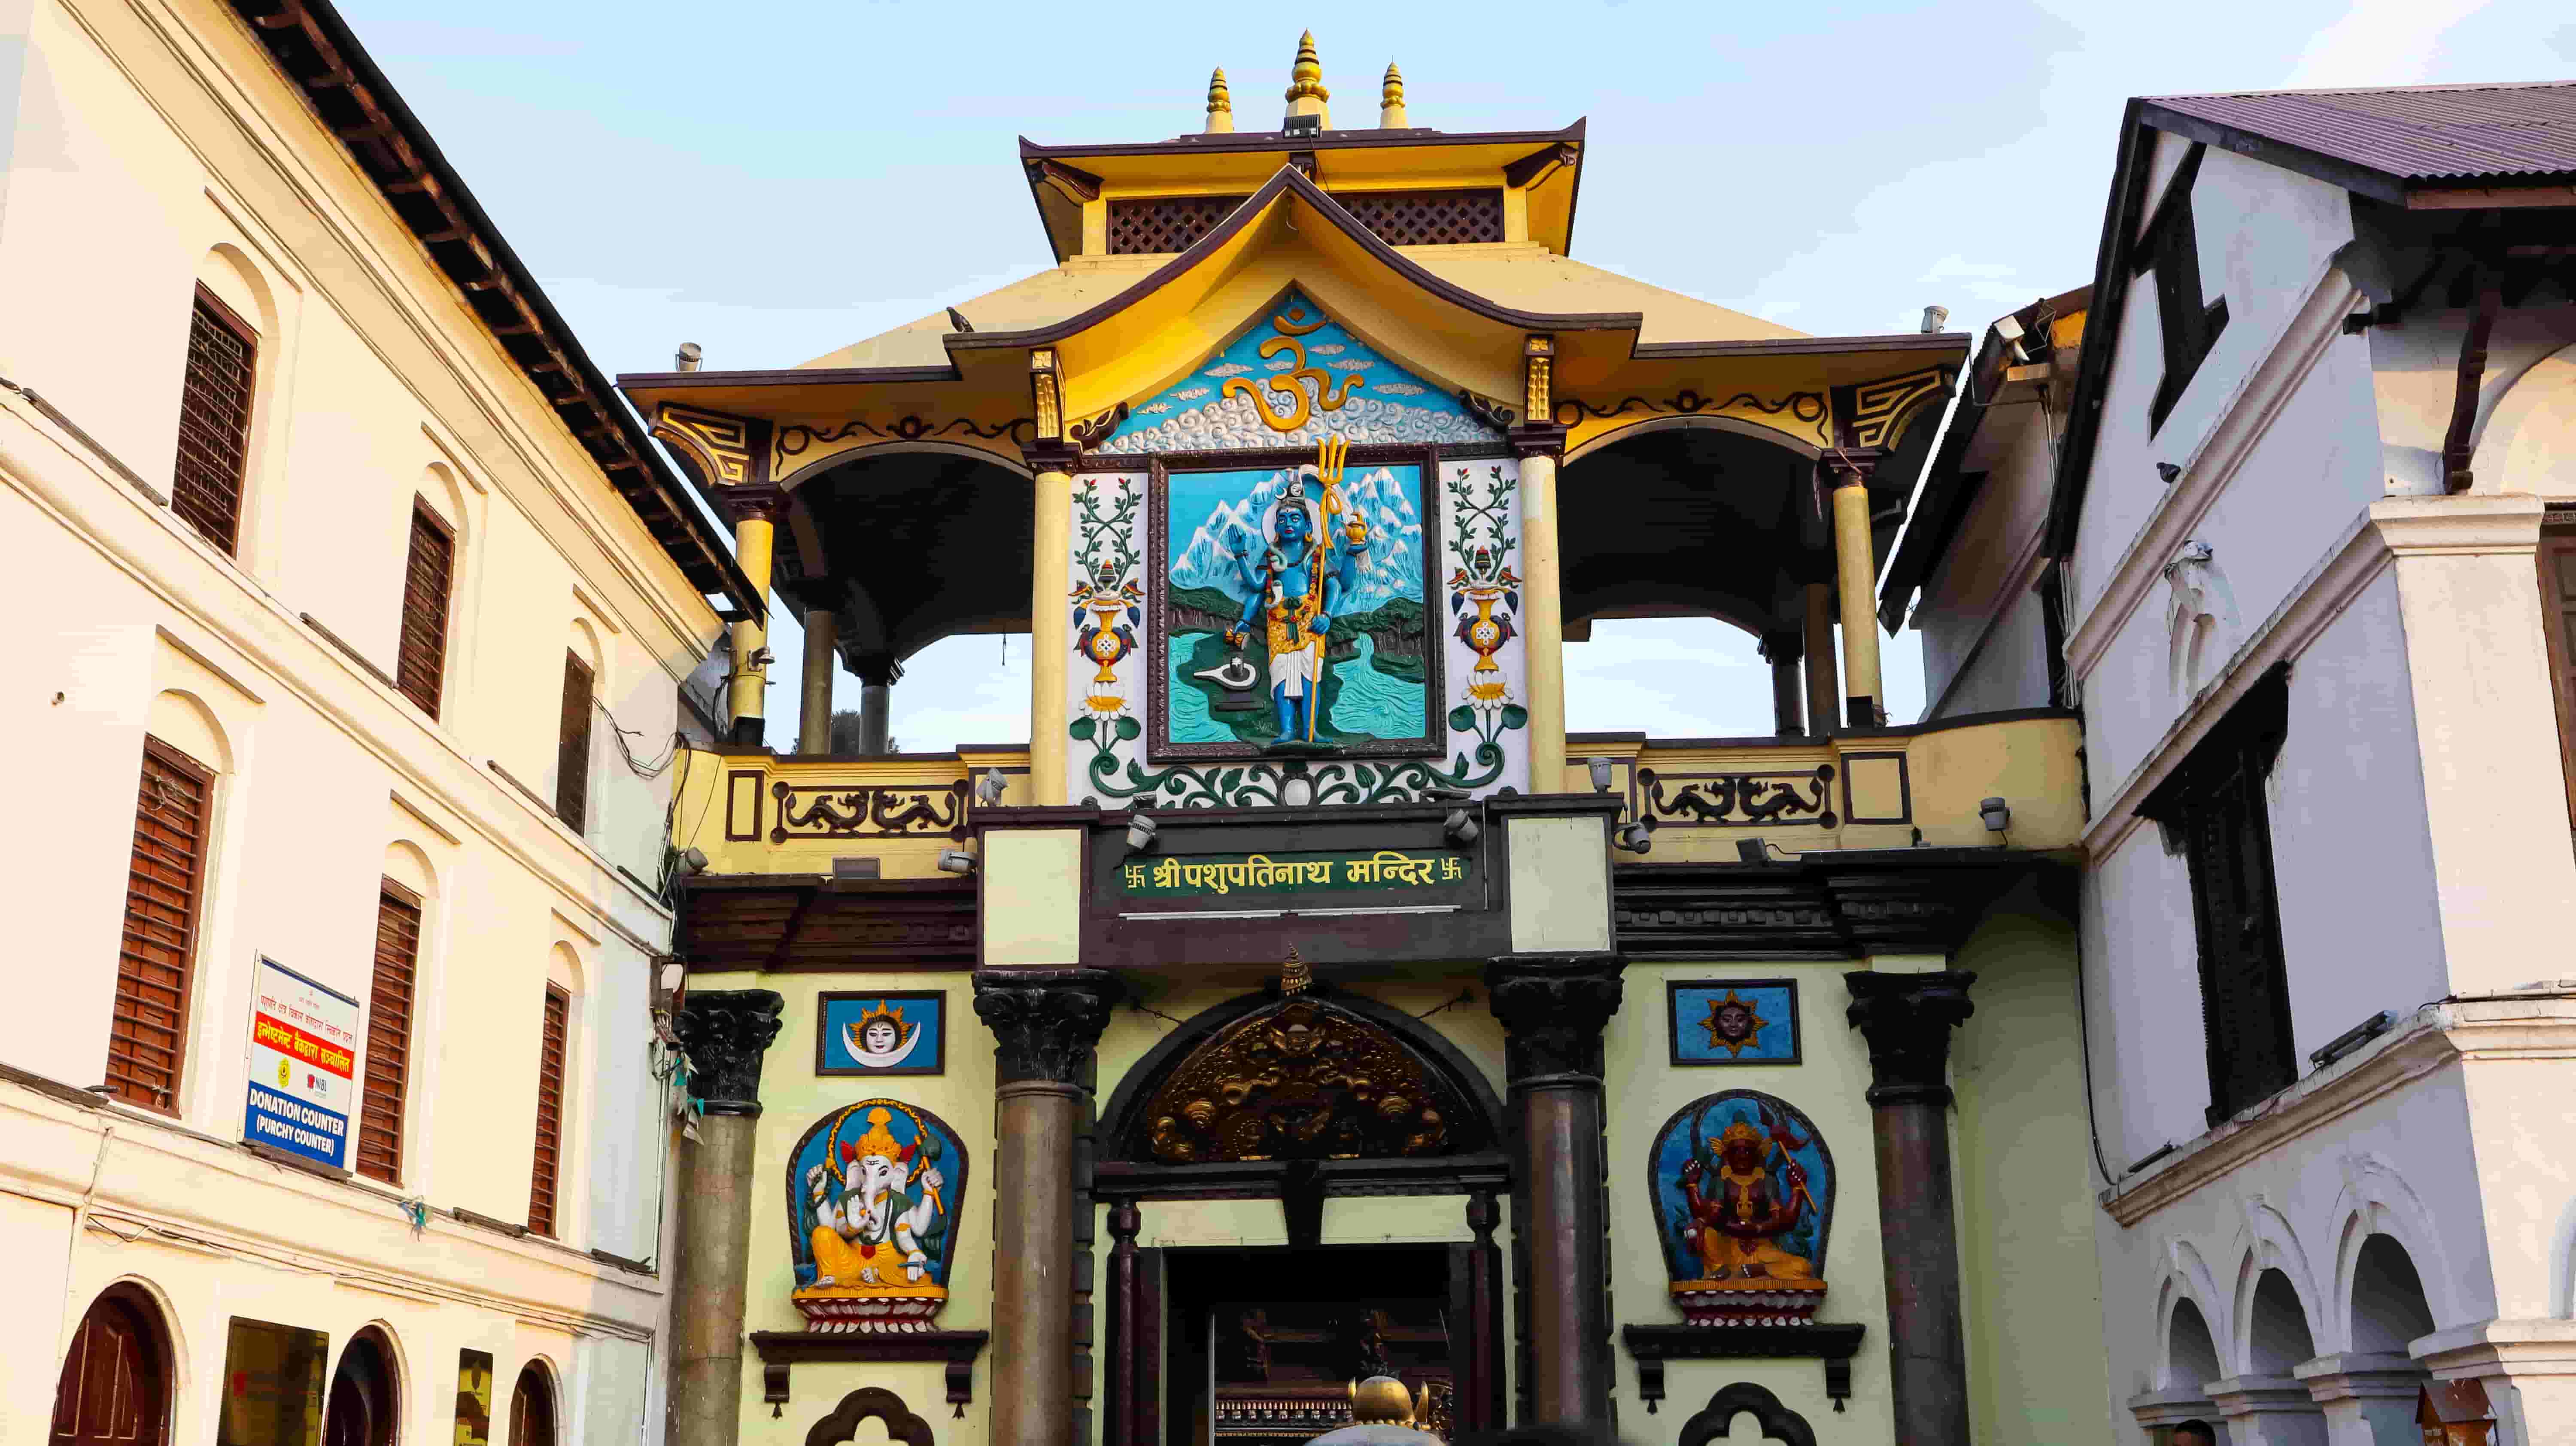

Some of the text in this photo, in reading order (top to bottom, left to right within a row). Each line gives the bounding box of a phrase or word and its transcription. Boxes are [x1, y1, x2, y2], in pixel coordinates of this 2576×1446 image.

[1346, 851, 1435, 886] मन्दिर
[316, 1077, 327, 1092] NIBL
[249, 1088, 344, 1137] DONATION COUNTER
[256, 1114, 334, 1157] (PURCHY COUNTER)
